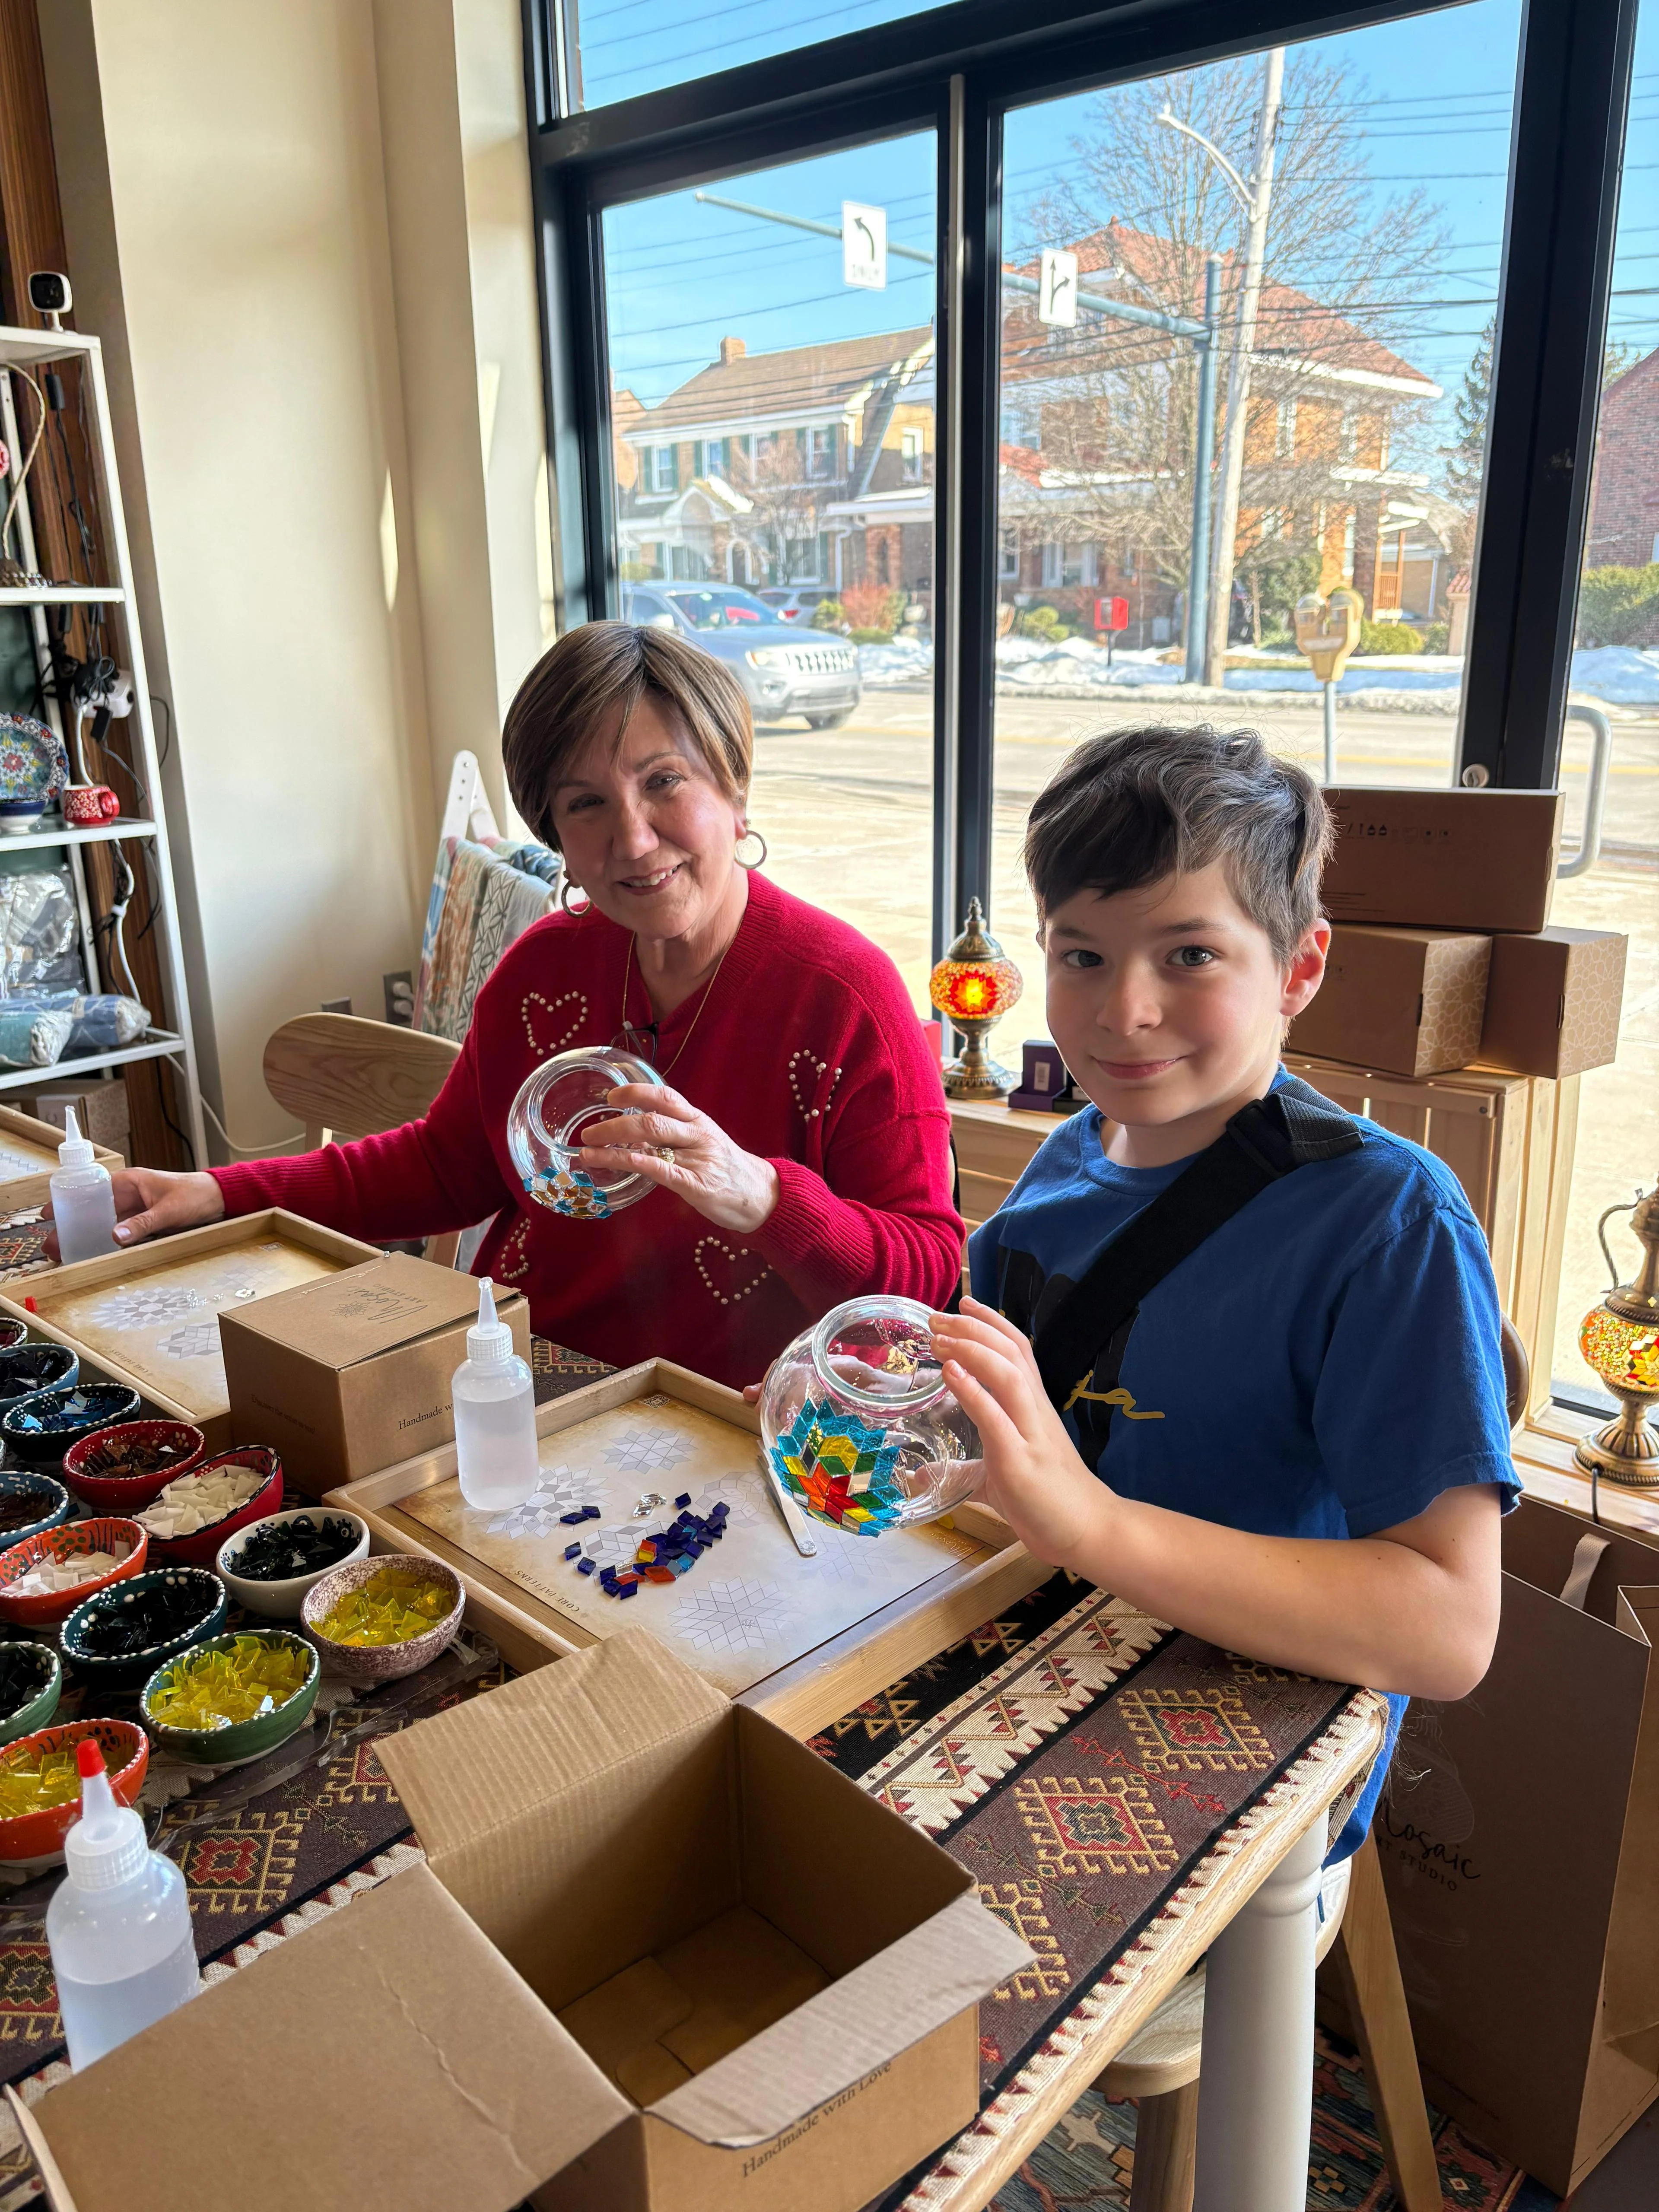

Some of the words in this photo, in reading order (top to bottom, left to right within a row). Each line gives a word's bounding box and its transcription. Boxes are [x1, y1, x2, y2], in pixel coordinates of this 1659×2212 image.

[372, 1284, 406, 1297] STUDIO
[398, 1406, 443, 1430] Handmade
[515, 1570, 556, 1597] PATTERNS
[555, 1596, 580, 1612] CORE
[1372, 1796, 1481, 1879] osaic
[1399, 1850, 1458, 1891] STUDIO
[742, 2114, 819, 2178] Handmade
[822, 2088, 856, 2117] with
[859, 2061, 891, 2091] Love
